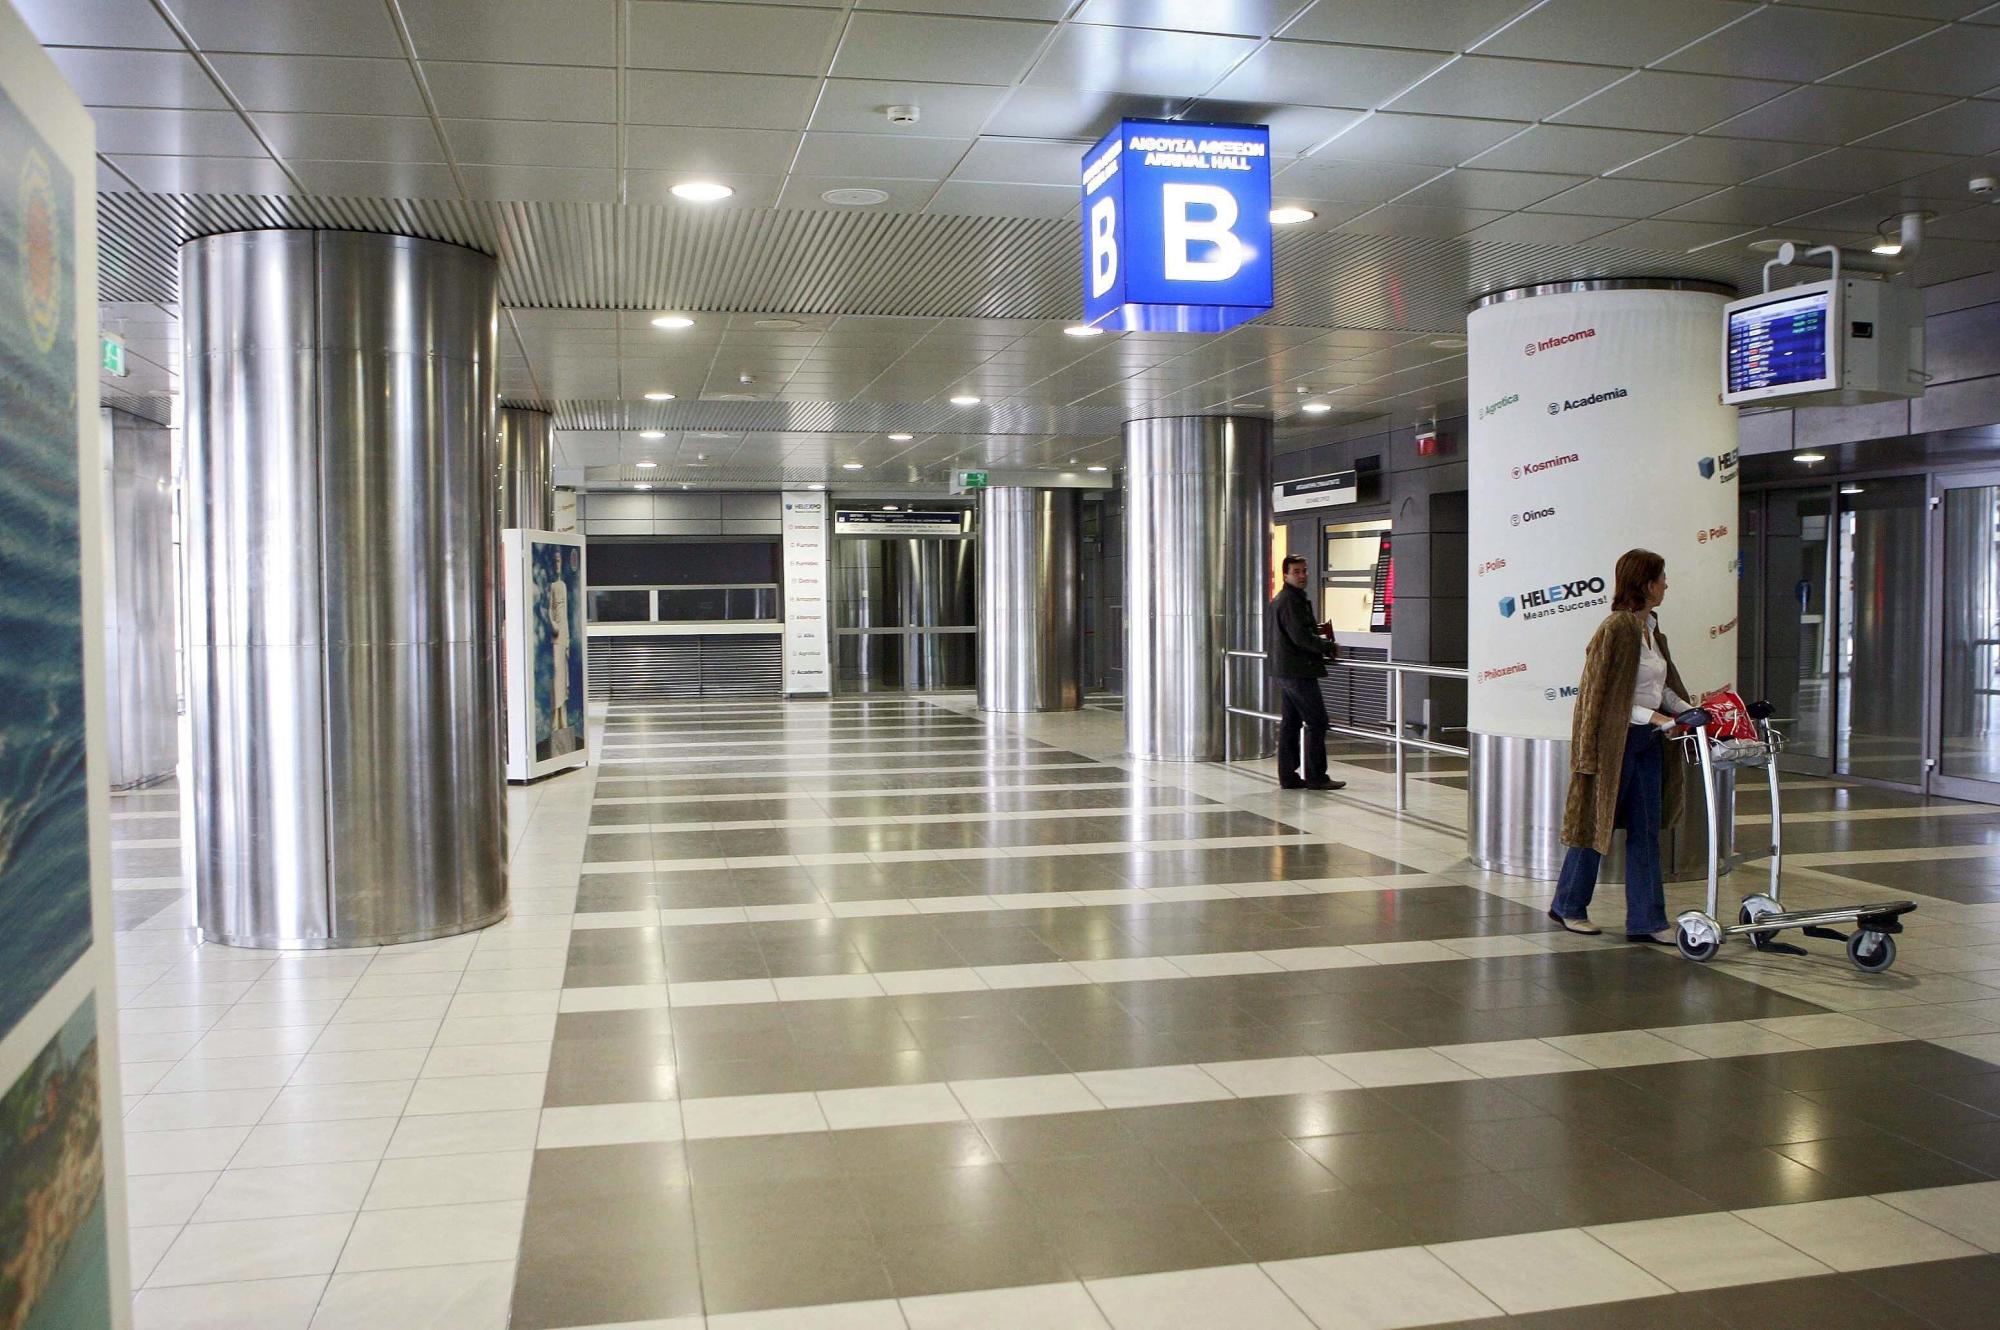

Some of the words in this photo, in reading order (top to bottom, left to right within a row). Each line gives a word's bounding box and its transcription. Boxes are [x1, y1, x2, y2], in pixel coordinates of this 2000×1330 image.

[1211, 154, 1252, 171] HALL
[1162, 183, 1244, 282] B
[1091, 196, 1118, 299] B
[1537, 326, 1597, 353] Infacoma
[1563, 386, 1628, 412] Academia
[1523, 451, 1580, 476] Kosmima
[1522, 505, 1556, 523] Oinos
[1709, 525, 1728, 541] Polis
[1485, 558, 1506, 574] Polis
[1520, 576, 1606, 610] HELEXPO
[1523, 606, 1556, 622] Means
[1557, 595, 1608, 614] Success!
[1484, 661, 1528, 682] Philoxenia
